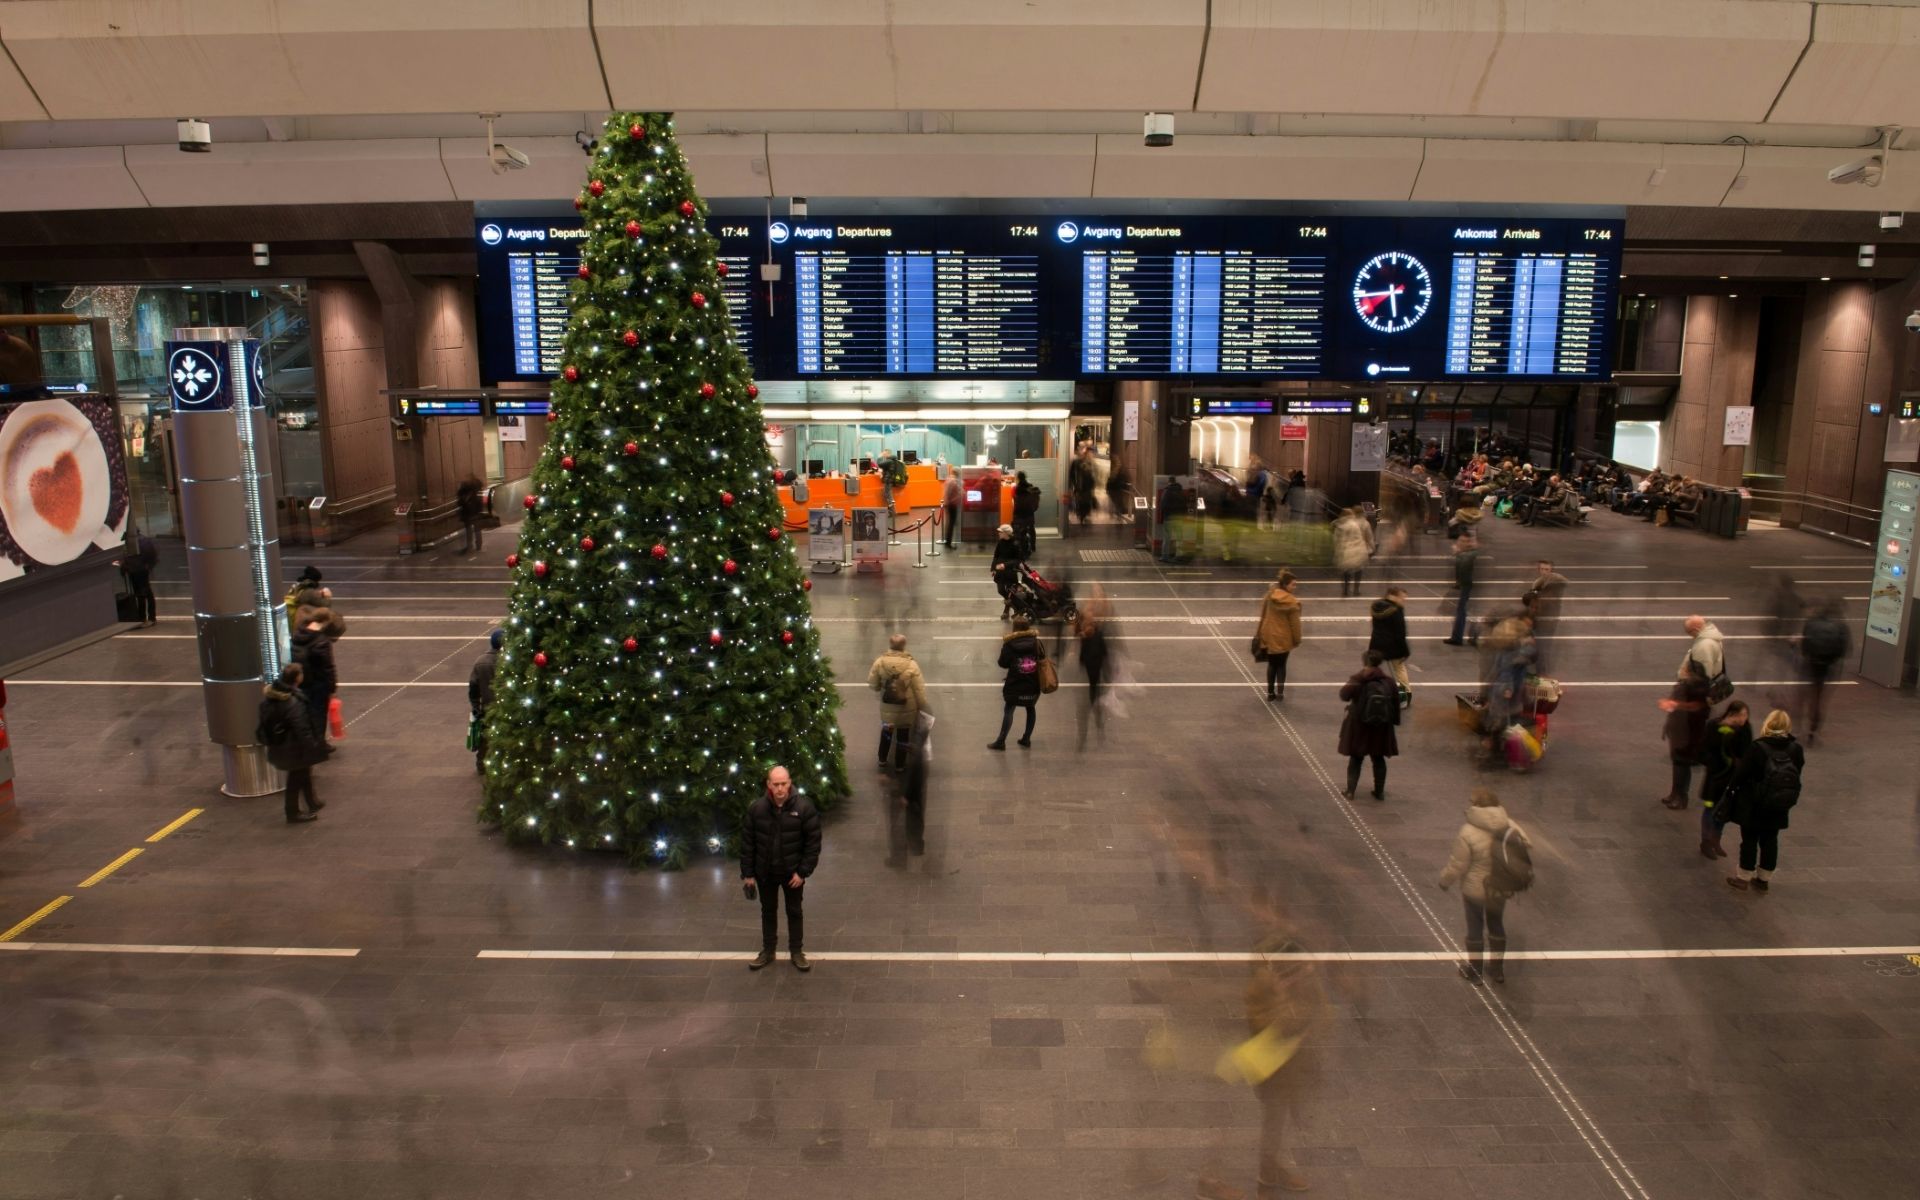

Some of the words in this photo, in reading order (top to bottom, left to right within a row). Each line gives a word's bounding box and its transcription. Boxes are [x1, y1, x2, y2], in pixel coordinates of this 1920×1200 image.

[507, 228, 545, 241] Avgang
[721, 227, 749, 237] 17:44
[794, 226, 832, 239] Avgang
[837, 226, 892, 238] Departures
[1010, 226, 1038, 236] 17:44
[1083, 226, 1122, 239] Avgang
[1126, 226, 1181, 238] Departures
[1299, 227, 1327, 237] 17:44
[1454, 228, 1497, 239] Ankomst
[1503, 229, 1541, 239] Arrivals
[1584, 230, 1611, 240] 17:44
[1194, 405, 1200, 413] 9
[1358, 404, 1369, 413] 10
[1903, 408, 1912, 416] 11
